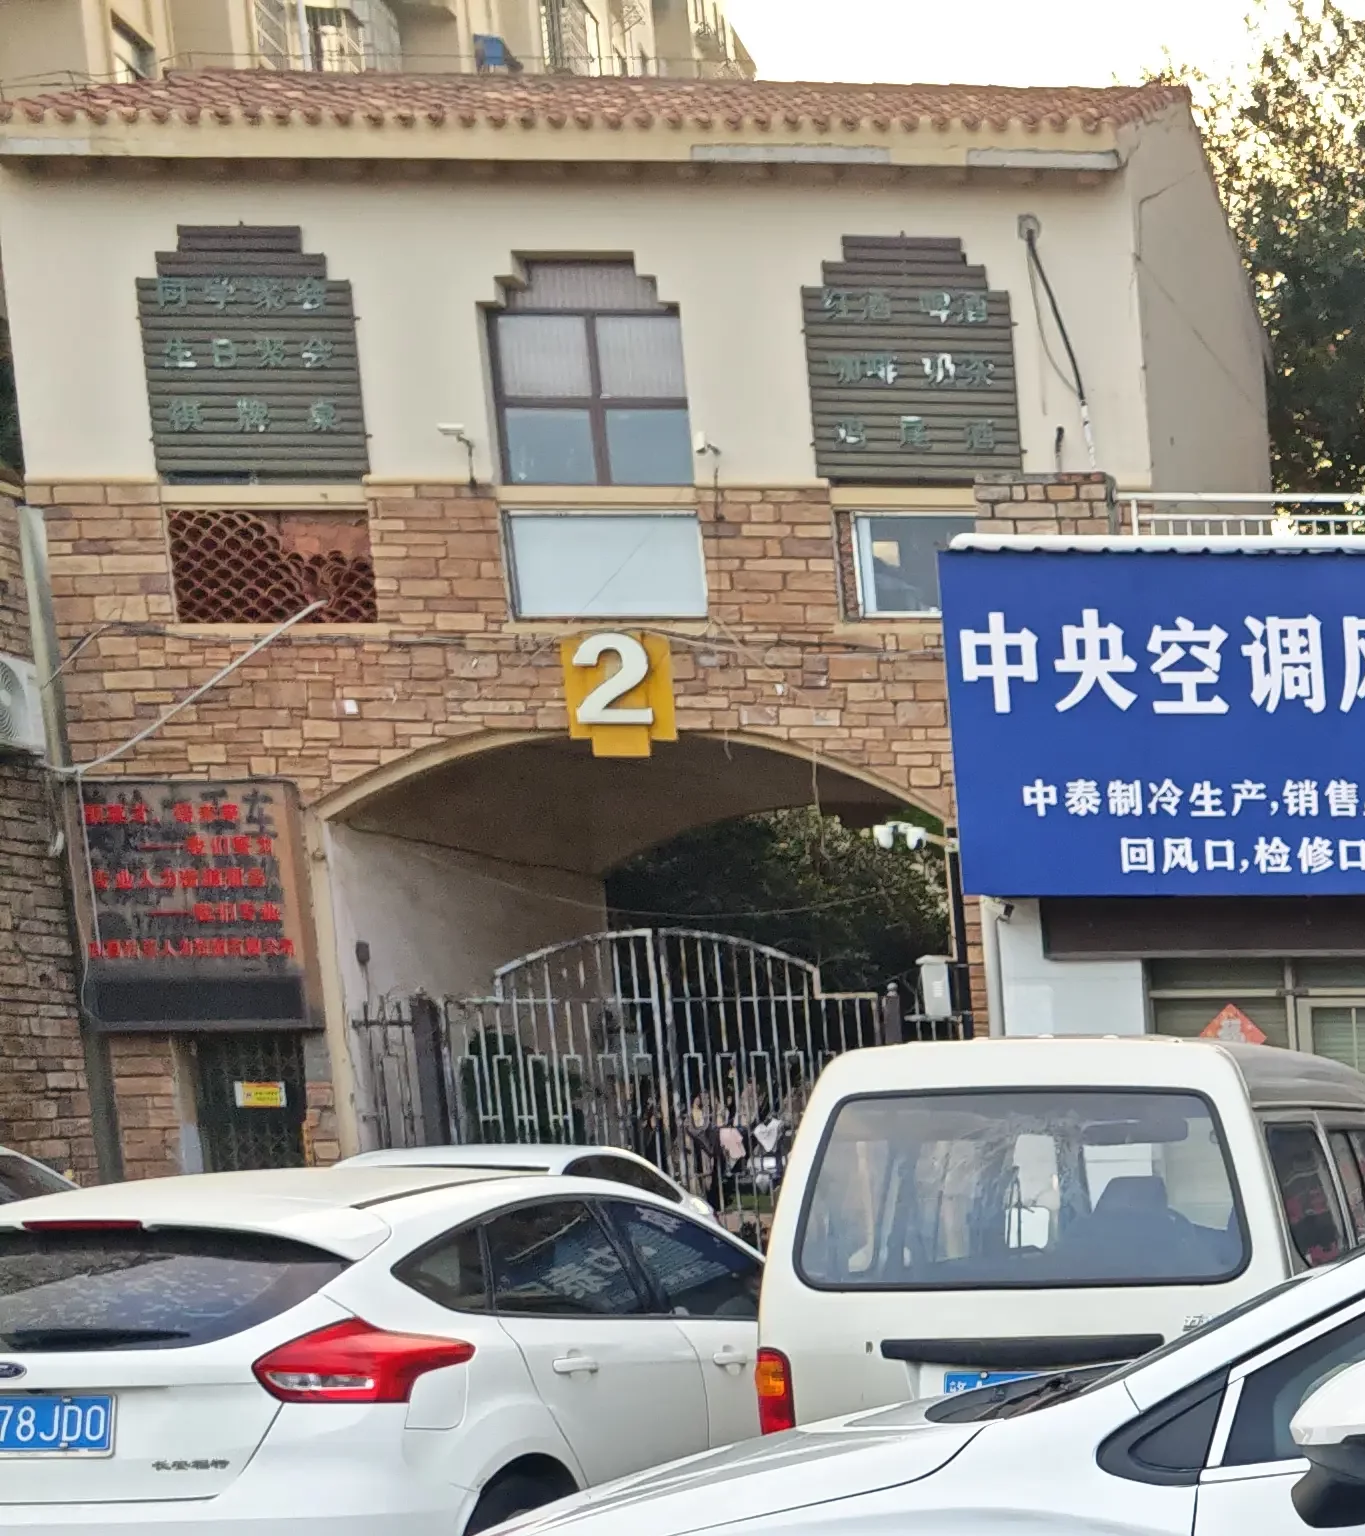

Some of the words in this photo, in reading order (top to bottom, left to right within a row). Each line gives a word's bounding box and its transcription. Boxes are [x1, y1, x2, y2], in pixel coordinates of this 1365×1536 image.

[163, 336, 334, 368] 生日聚会
[572, 632, 655, 726] 2
